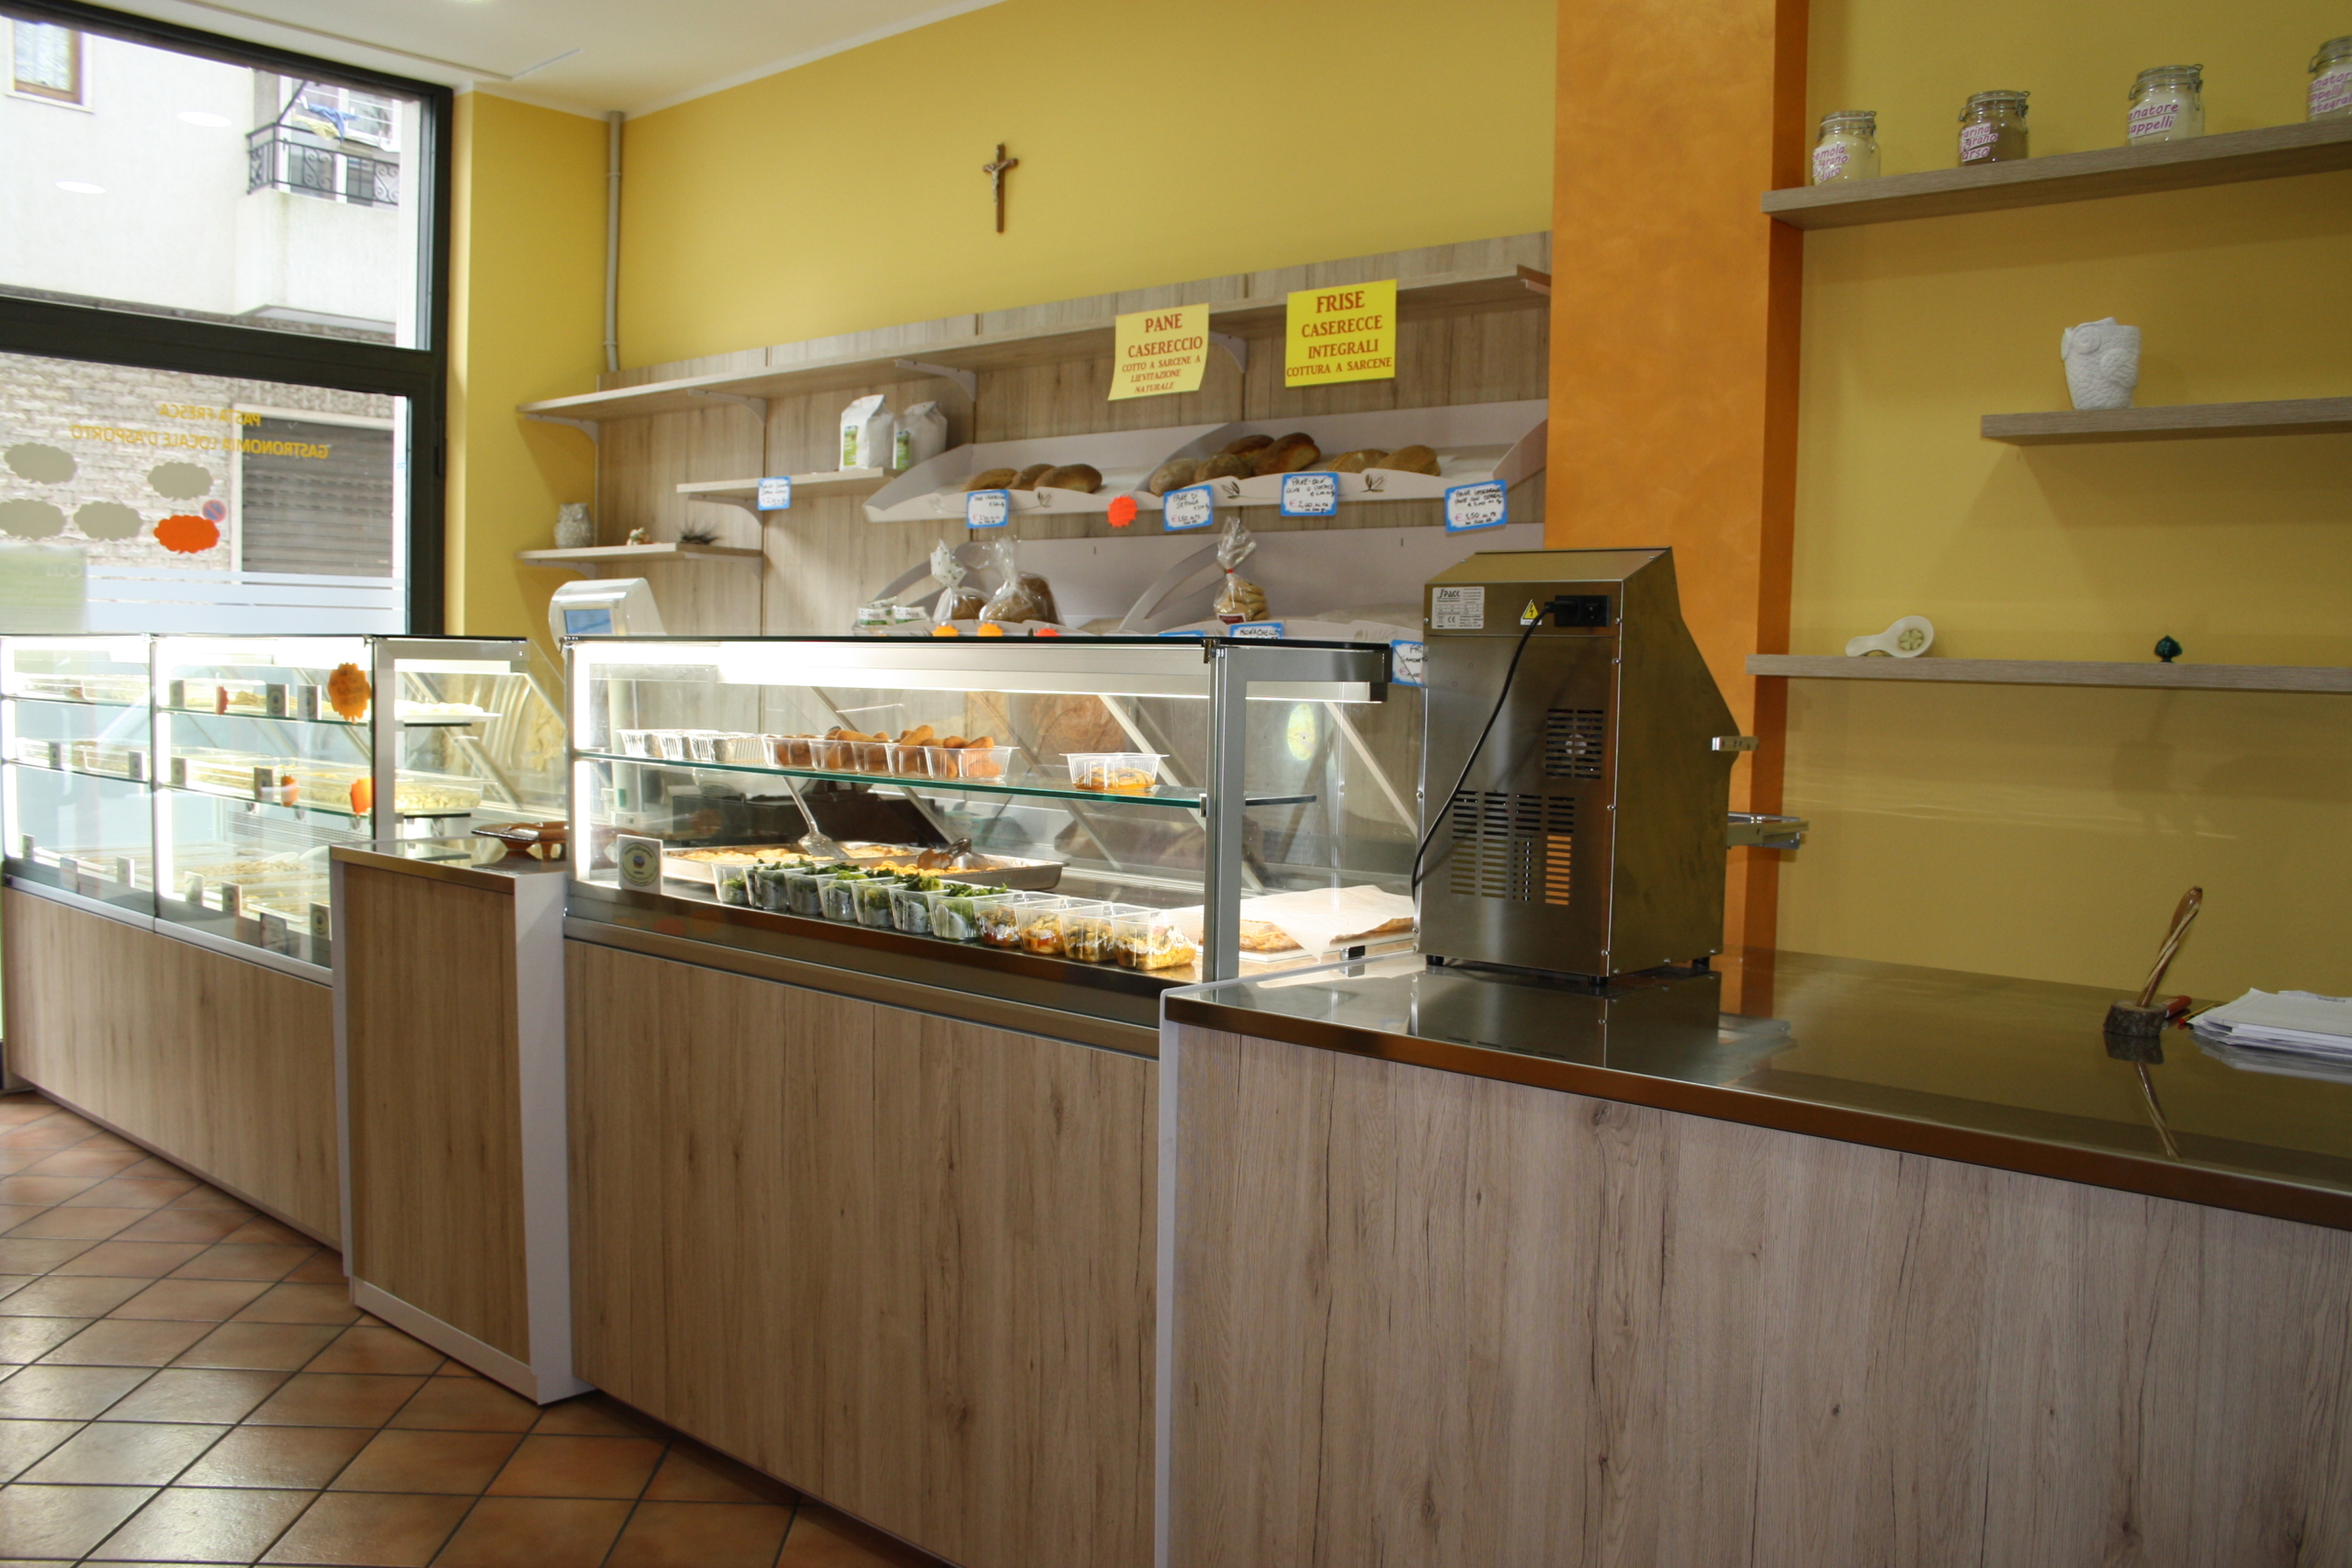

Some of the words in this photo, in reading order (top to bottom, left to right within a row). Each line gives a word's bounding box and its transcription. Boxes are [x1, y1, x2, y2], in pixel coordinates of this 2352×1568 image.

[2127, 104, 2179, 121] enatore
[1966, 134, 1997, 150] grano
[1813, 143, 1846, 161] emola
[1820, 167, 1841, 182] duro
[1316, 290, 1365, 313] FRISE
[1145, 313, 1182, 333] PANE
[1302, 315, 1383, 338] CASERECCE
[1128, 336, 1203, 358] CASERECCIO
[1308, 339, 1379, 359] INTEGRALI
[1122, 362, 1147, 372] COTTO
[1149, 361, 1155, 369] A
[1159, 355, 1192, 367] SARCENE
[1195, 355, 1201, 363] A
[1286, 364, 1331, 377] COTTURA
[1336, 363, 1342, 372] A
[1347, 357, 1392, 371] SARCENE
[1131, 368, 1182, 382] LIEVITAZIONE
[1135, 381, 1175, 393] NATURALE
